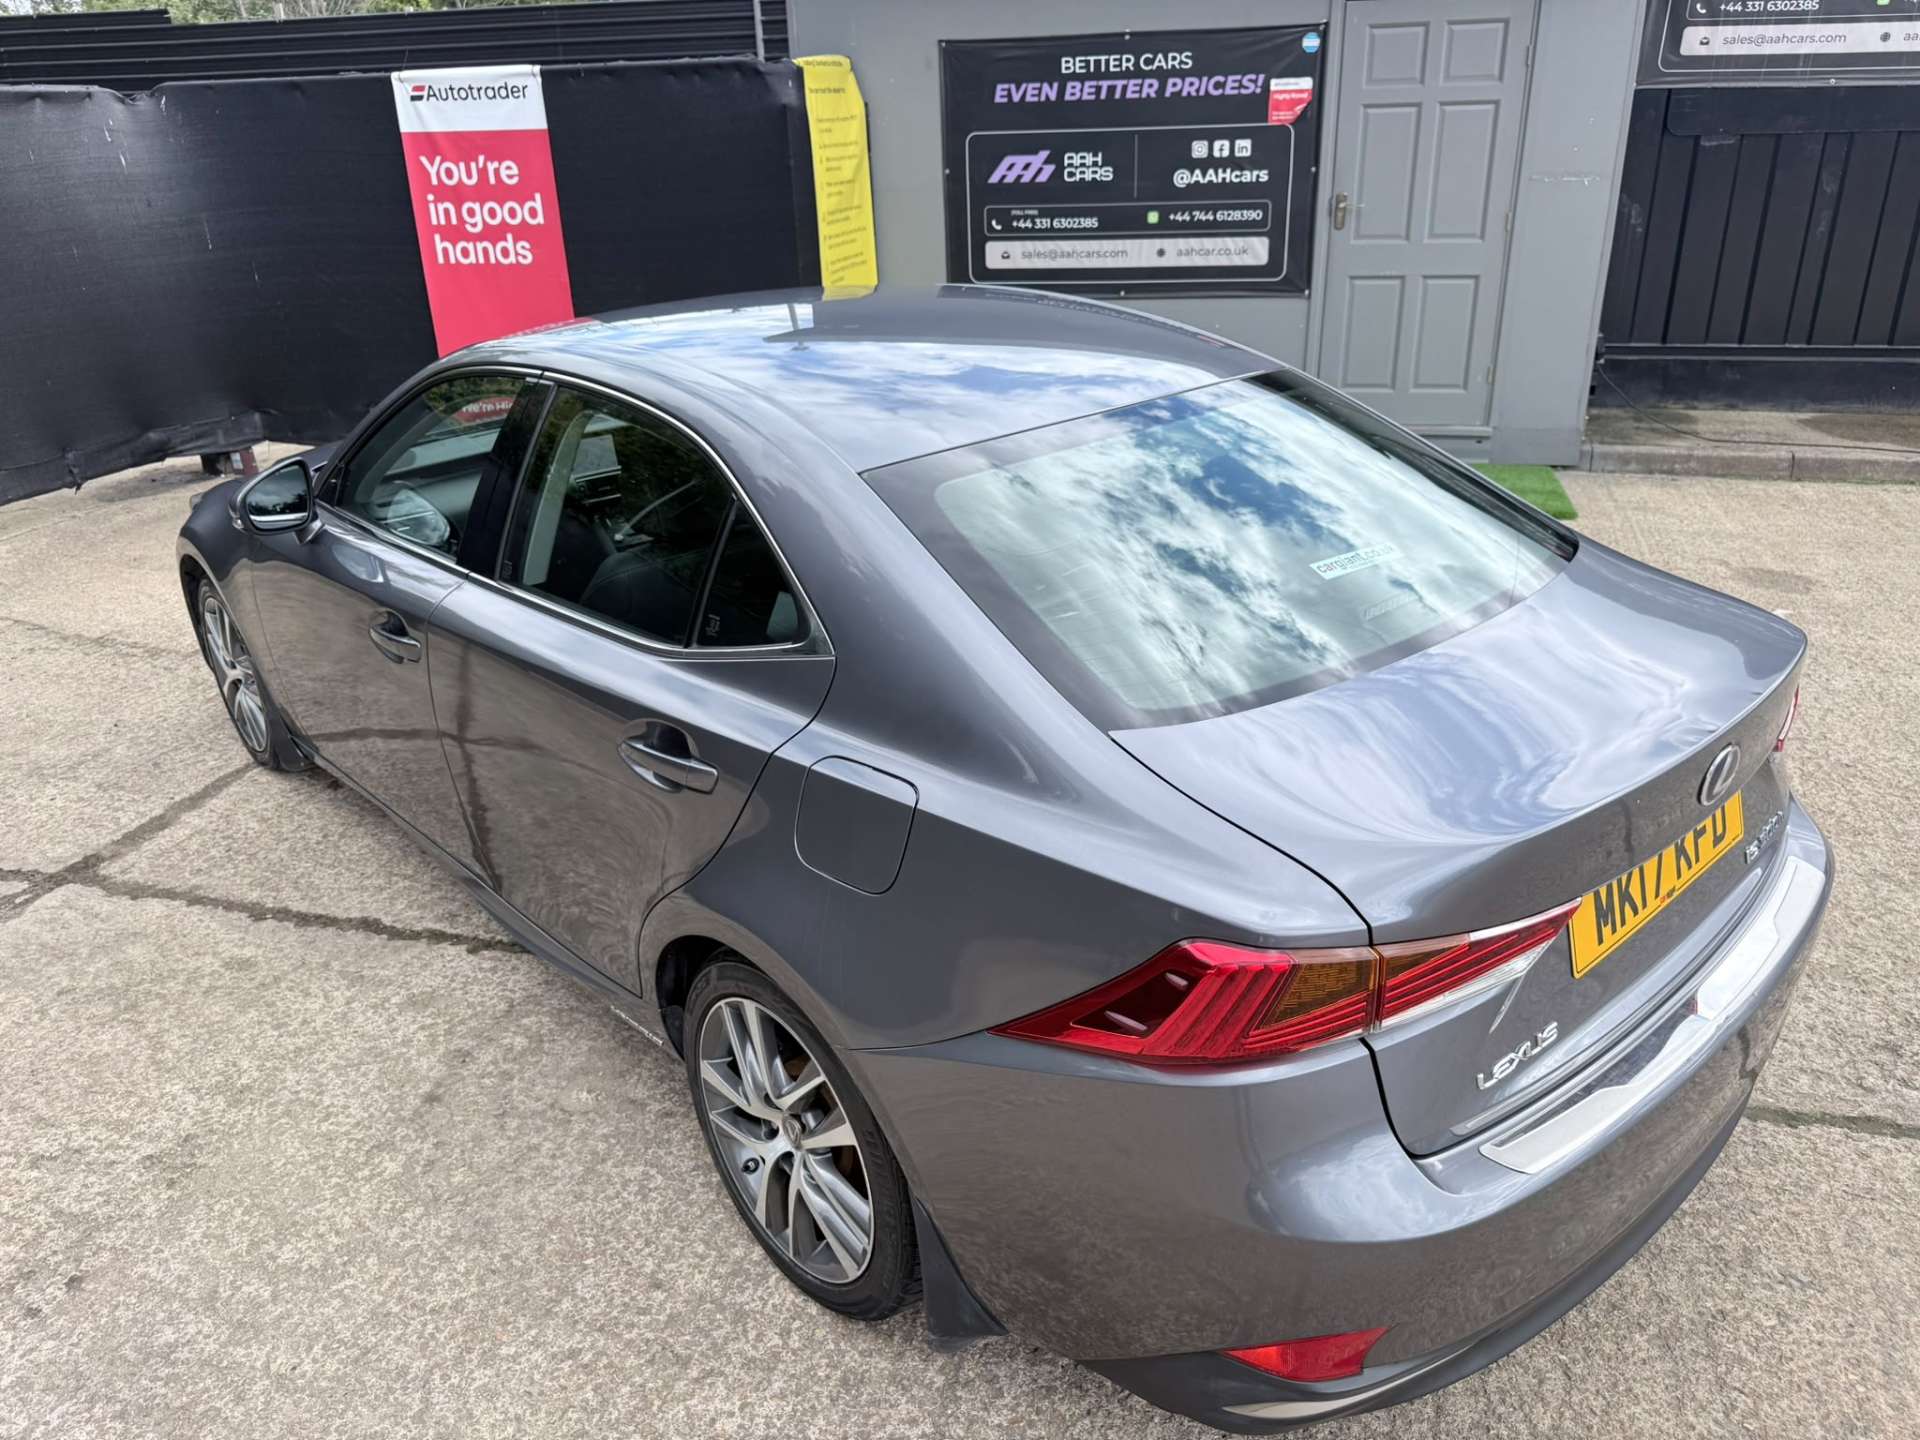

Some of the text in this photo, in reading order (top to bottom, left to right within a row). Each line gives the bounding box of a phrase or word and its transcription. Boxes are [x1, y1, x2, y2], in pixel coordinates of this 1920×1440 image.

[1720, 2, 1743, 12] +44
[1745, 1, 1764, 12] 331
[1722, 33, 1847, 47] sales@aahcars.com
[1060, 51, 1193, 74] BETTER CARS
[425, 81, 529, 102] Autotrader
[994, 74, 1265, 103] EVEN BETTER PRICES!
[1063, 152, 1102, 167] AAH
[419, 155, 519, 186] You're
[1063, 166, 1114, 182] CARS
[1172, 167, 1269, 188] @AAHcars
[426, 192, 545, 233] in good
[1169, 209, 1263, 222] +44 744 6128390
[1012, 217, 1099, 229] +44 331 6302385
[434, 233, 533, 265] hands
[1021, 248, 1129, 261] sales@aahcars.com
[1176, 246, 1249, 257] aahcar.co.uk
[1477, 1021, 1558, 1090] LEXUS
